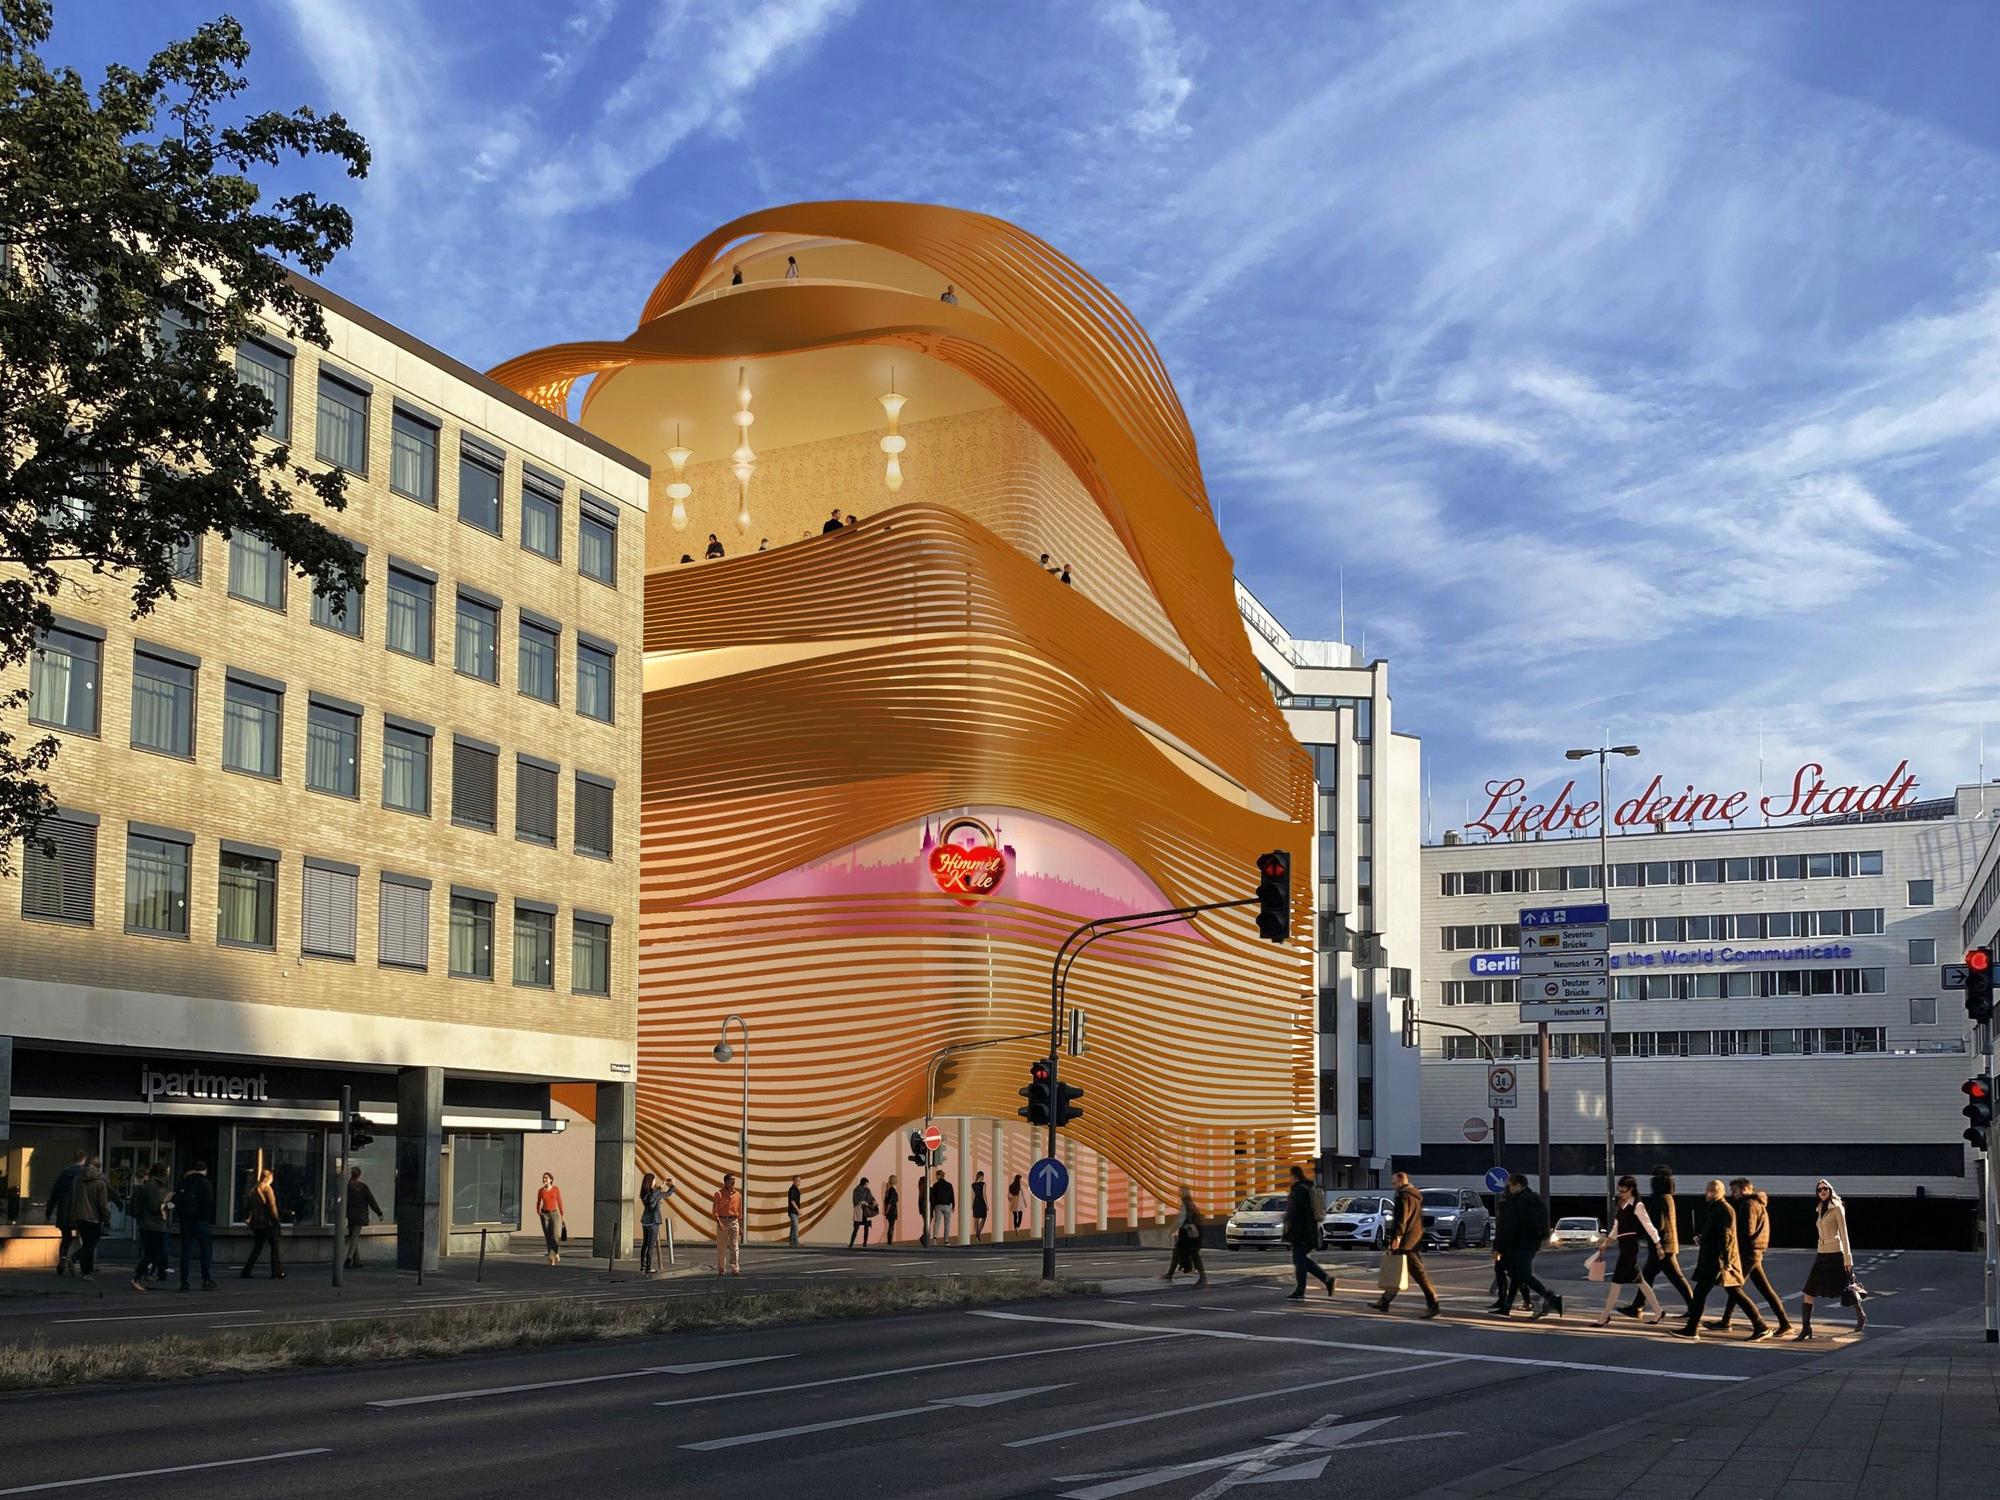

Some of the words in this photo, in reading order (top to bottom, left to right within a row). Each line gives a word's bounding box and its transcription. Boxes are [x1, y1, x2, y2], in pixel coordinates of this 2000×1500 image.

[1464, 778, 1600, 838] Liebe
[1614, 775, 1748, 825] deine
[1760, 760, 1920, 818] Stadt
[937, 853, 1000, 873] Himmel
[1562, 940, 1588, 949] Brücke
[1626, 952, 1655, 966] the
[1661, 948, 1714, 965] World
[1721, 944, 1852, 963] Communicate
[1476, 956, 1520, 972] Berli
[1553, 958, 1590, 968] Neumarkt
[1562, 979, 1590, 987] Deutzer
[1564, 988, 1590, 997] Brücke
[1554, 1007, 1590, 1016] Heumarkt
[141, 1064, 268, 1103] ipartment
